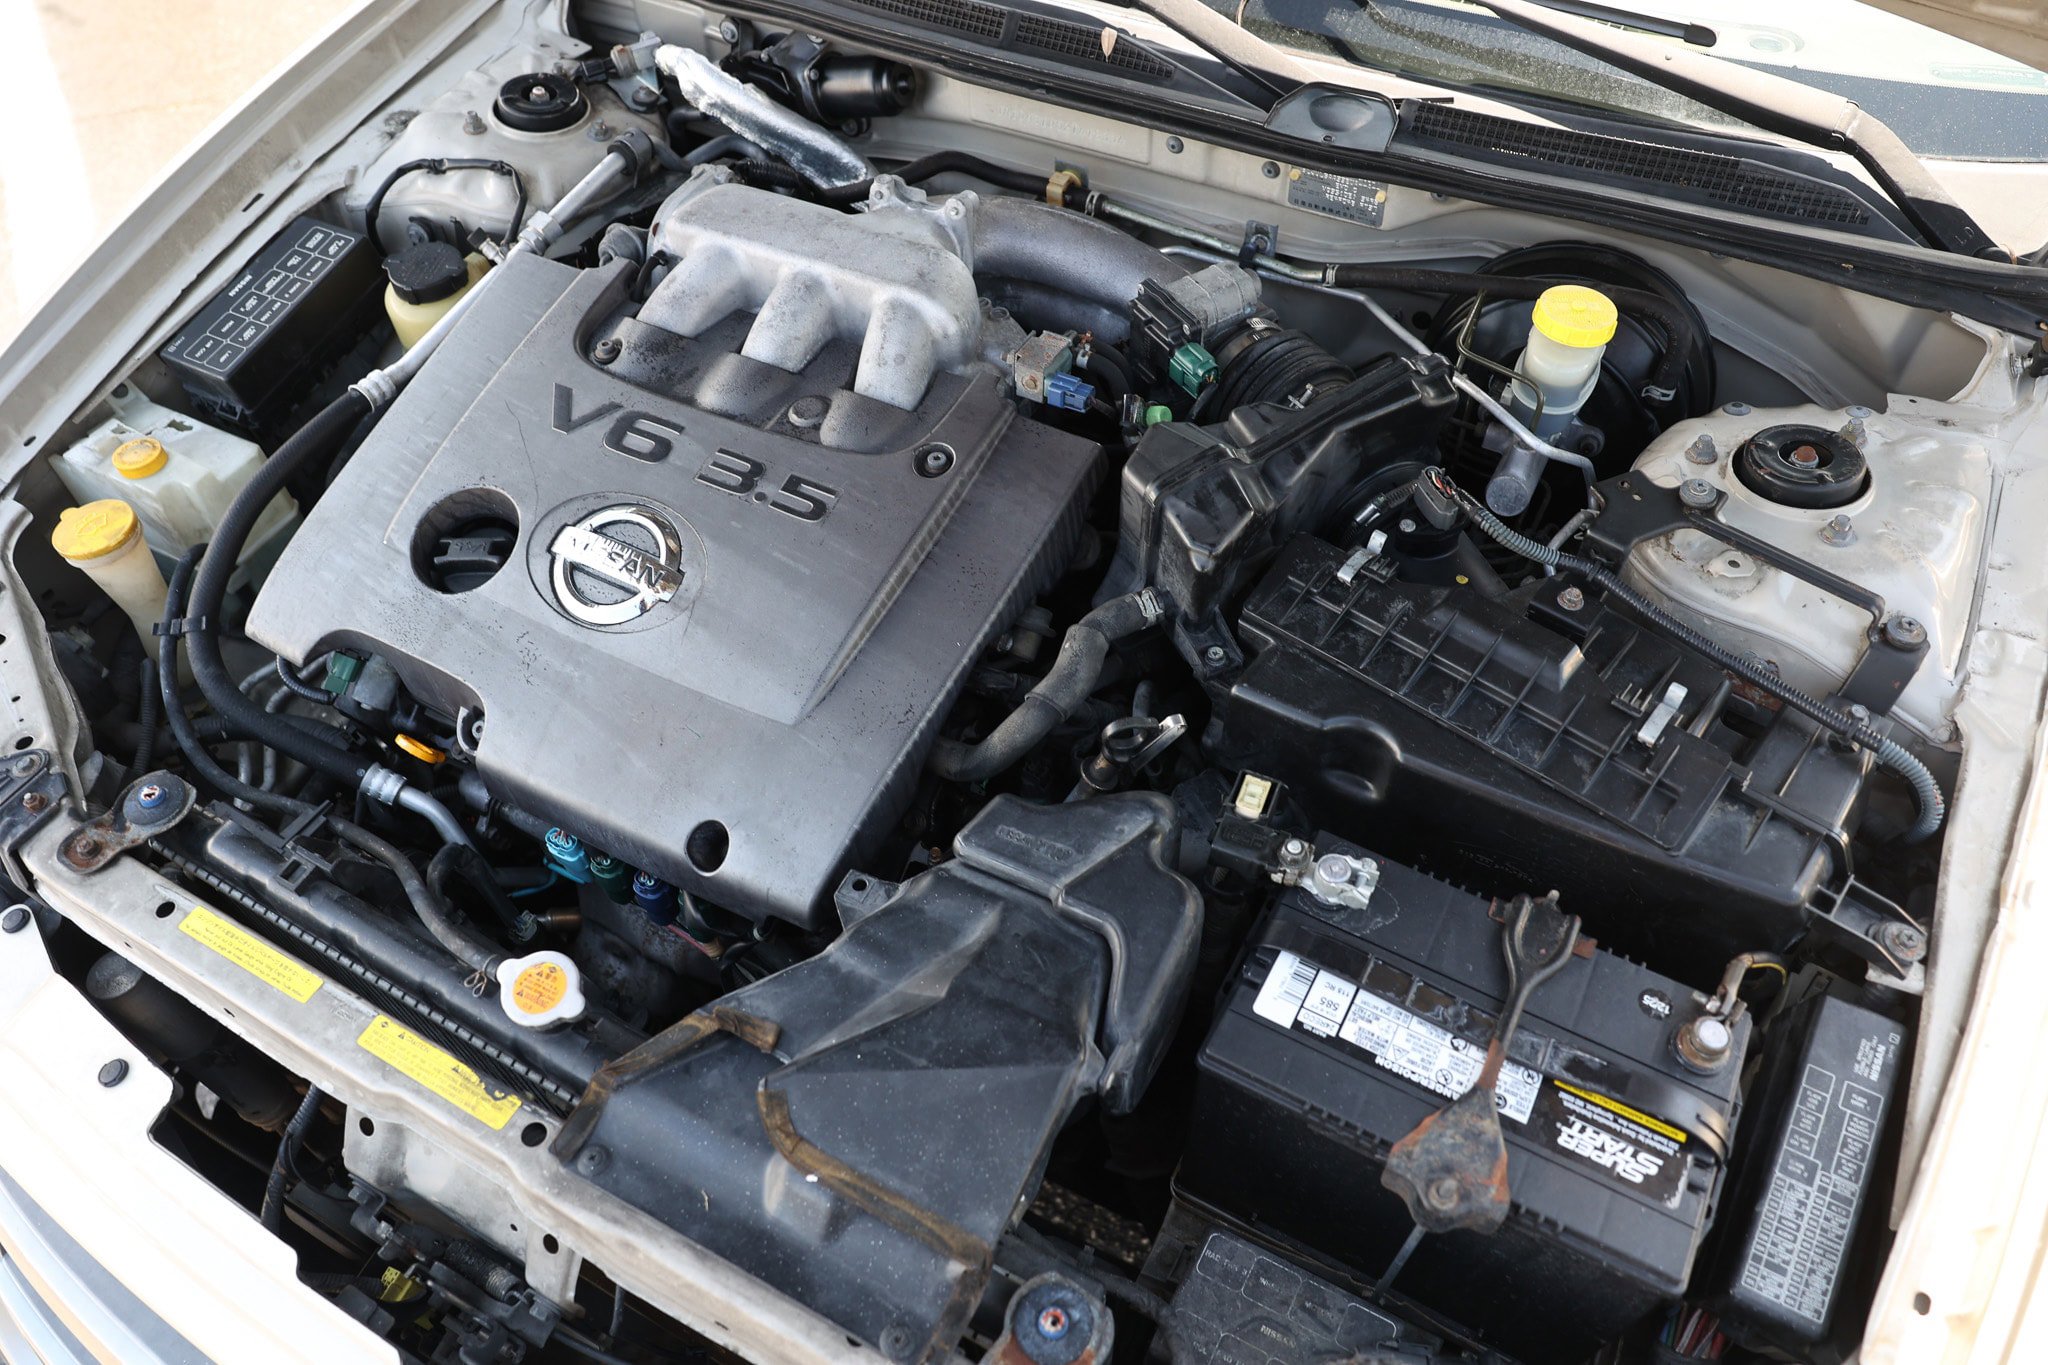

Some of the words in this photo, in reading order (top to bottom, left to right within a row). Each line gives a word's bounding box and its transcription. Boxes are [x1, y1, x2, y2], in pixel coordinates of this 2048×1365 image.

[552, 382, 685, 464] V6
[695, 448, 843, 522] 3.5
[566, 536, 665, 588] ISAN
[1317, 995, 1340, 1012] 585
[1373, 1055, 1461, 1101] ANGER/POISON
[1866, 1043, 1889, 1082] NISSAN
[1557, 1131, 1644, 1184] SUPER
[1560, 1120, 1664, 1176] START
